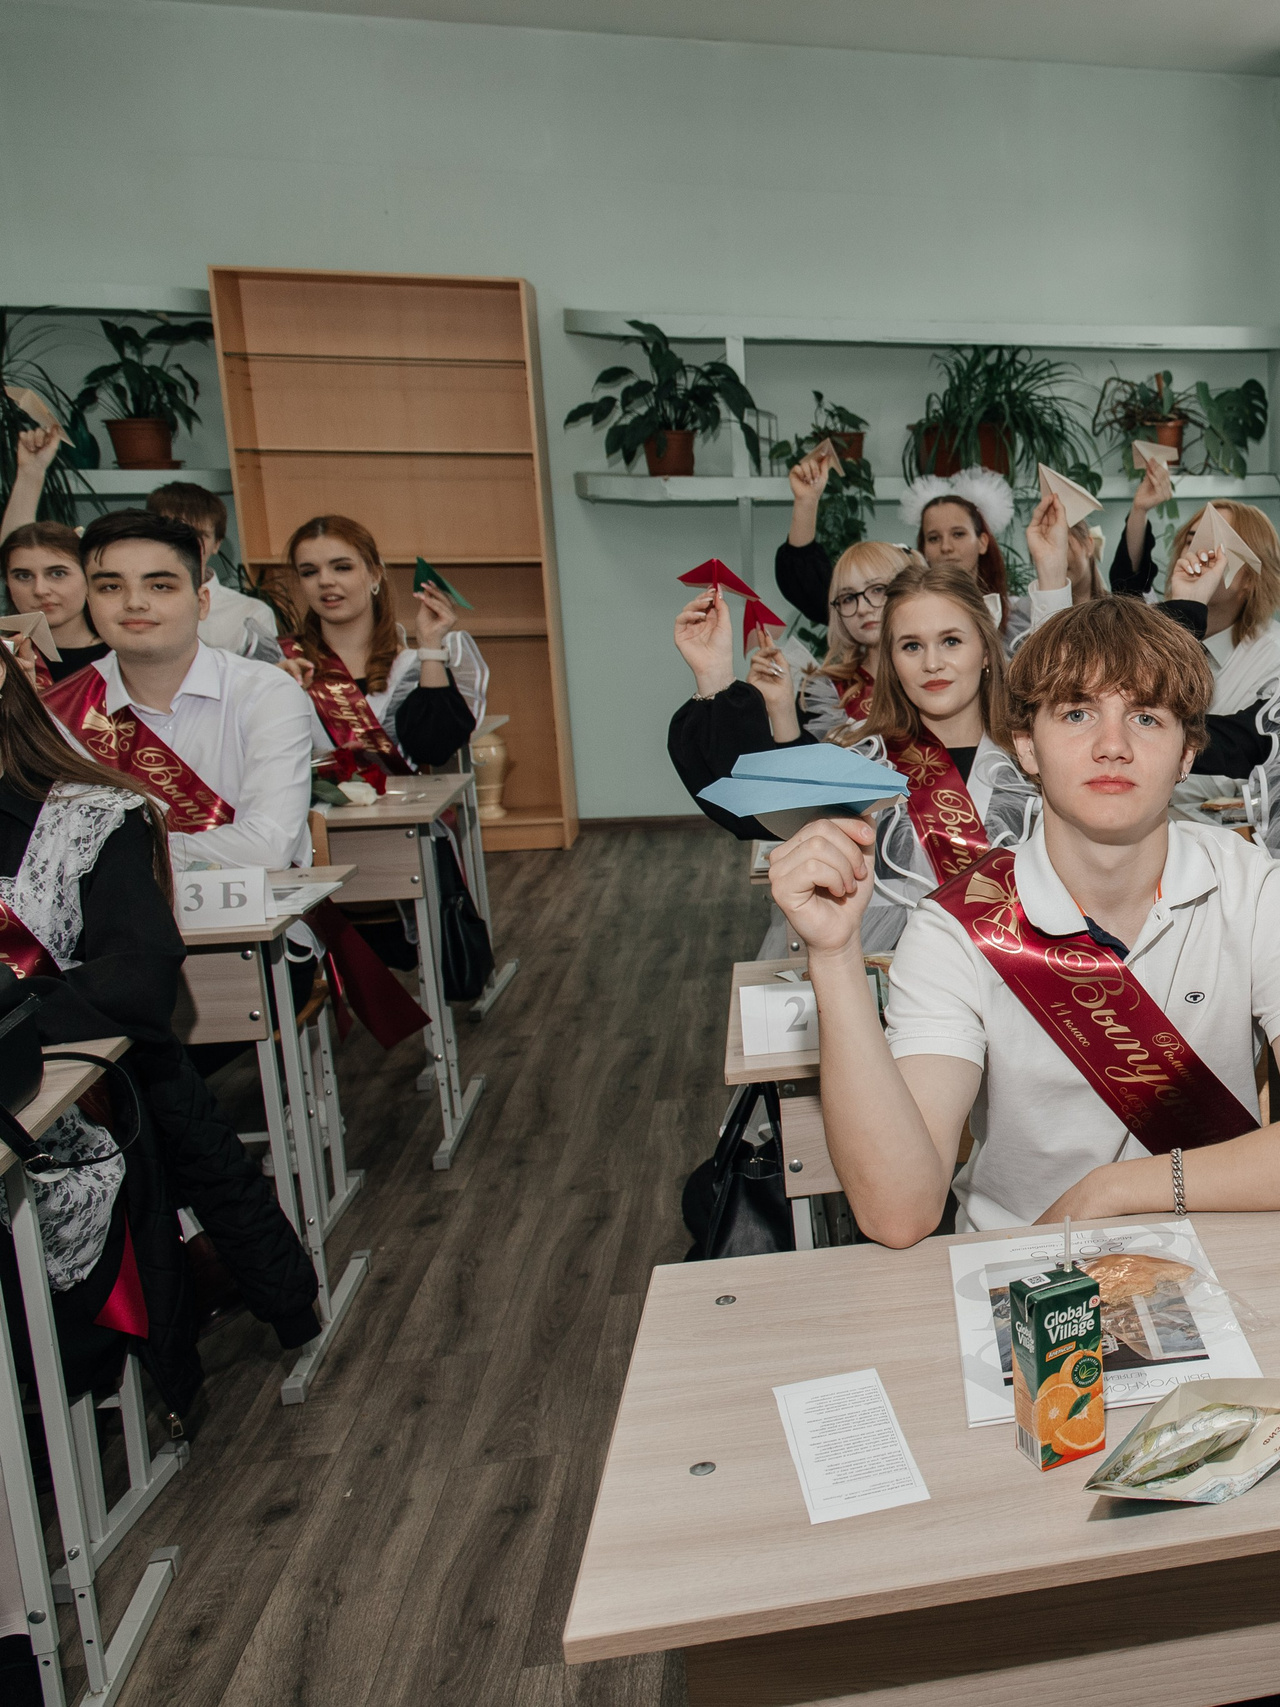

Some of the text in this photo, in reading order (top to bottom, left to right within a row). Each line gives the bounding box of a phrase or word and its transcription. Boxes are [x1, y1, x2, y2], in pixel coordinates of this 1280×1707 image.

[183, 880, 248, 912] 3 Б
[784, 996, 809, 1033] 2
[1050, 1001, 1091, 1049] 11 класс
[1043, 1301, 1088, 1330] Global
[1047, 1318, 1096, 1345] Village
